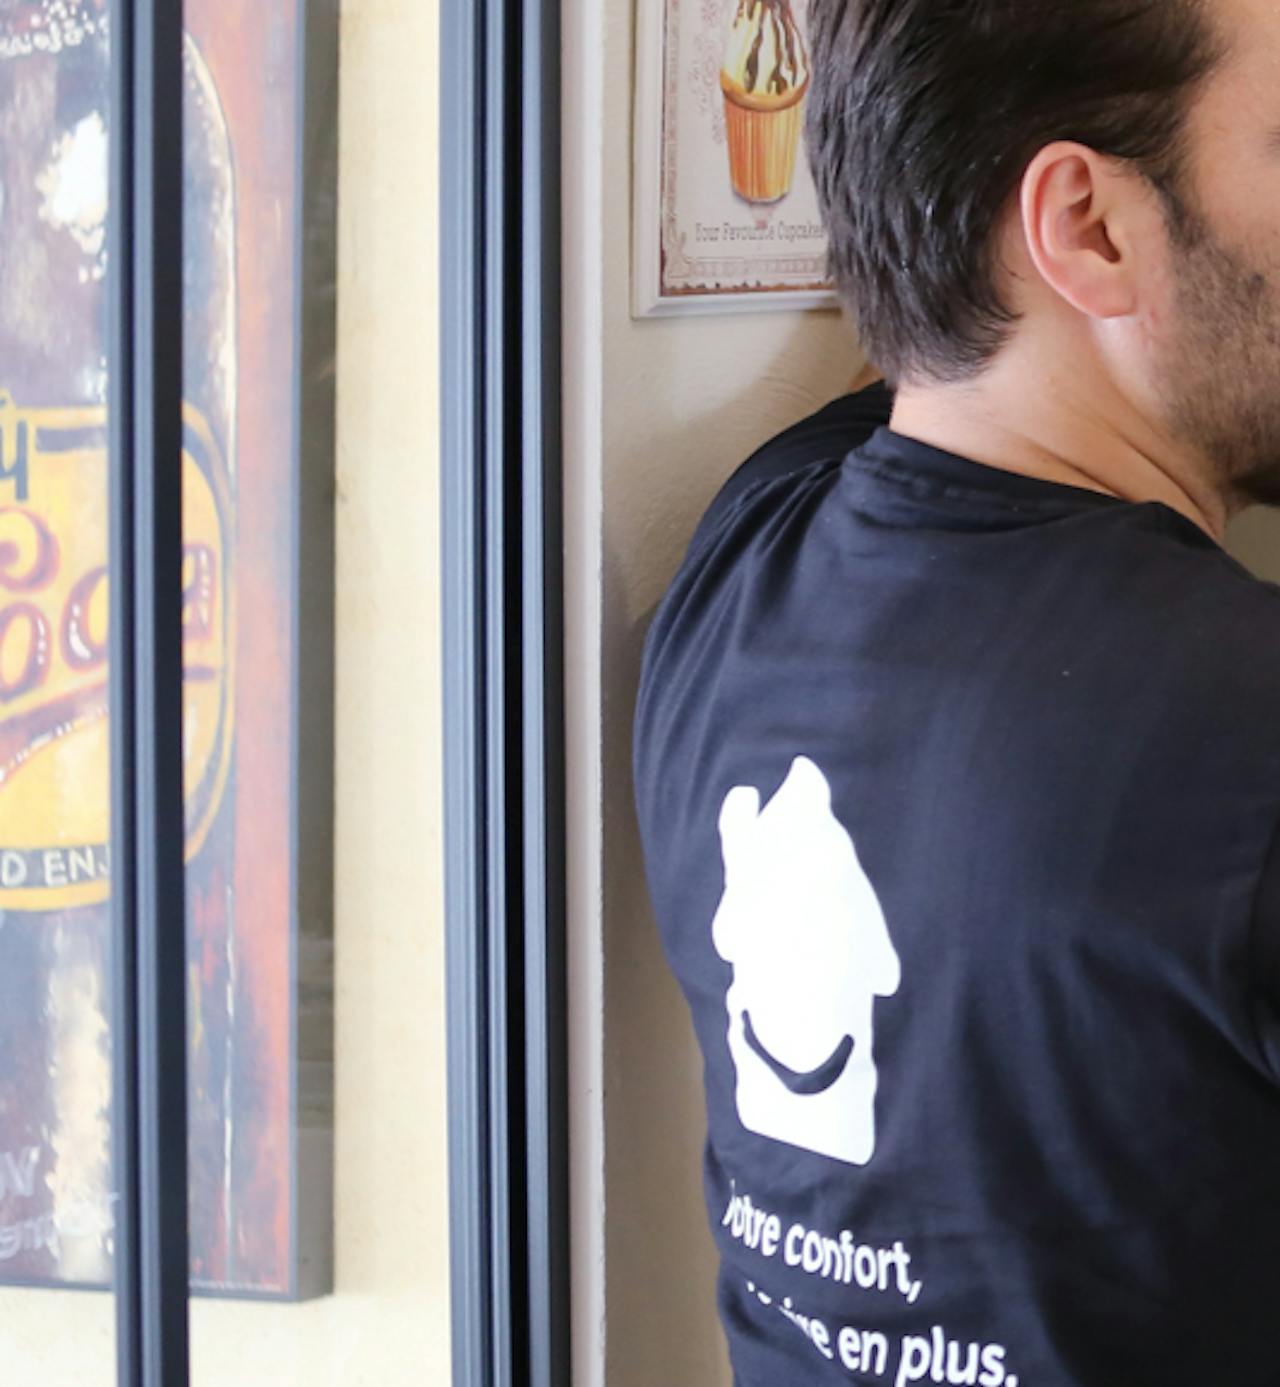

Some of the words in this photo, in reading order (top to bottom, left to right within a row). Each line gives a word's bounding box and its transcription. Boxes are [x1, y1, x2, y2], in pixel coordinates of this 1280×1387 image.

[784, 1223, 923, 1305] confort,
[838, 1326, 888, 1377] en
[894, 1325, 1019, 1387] plus.
